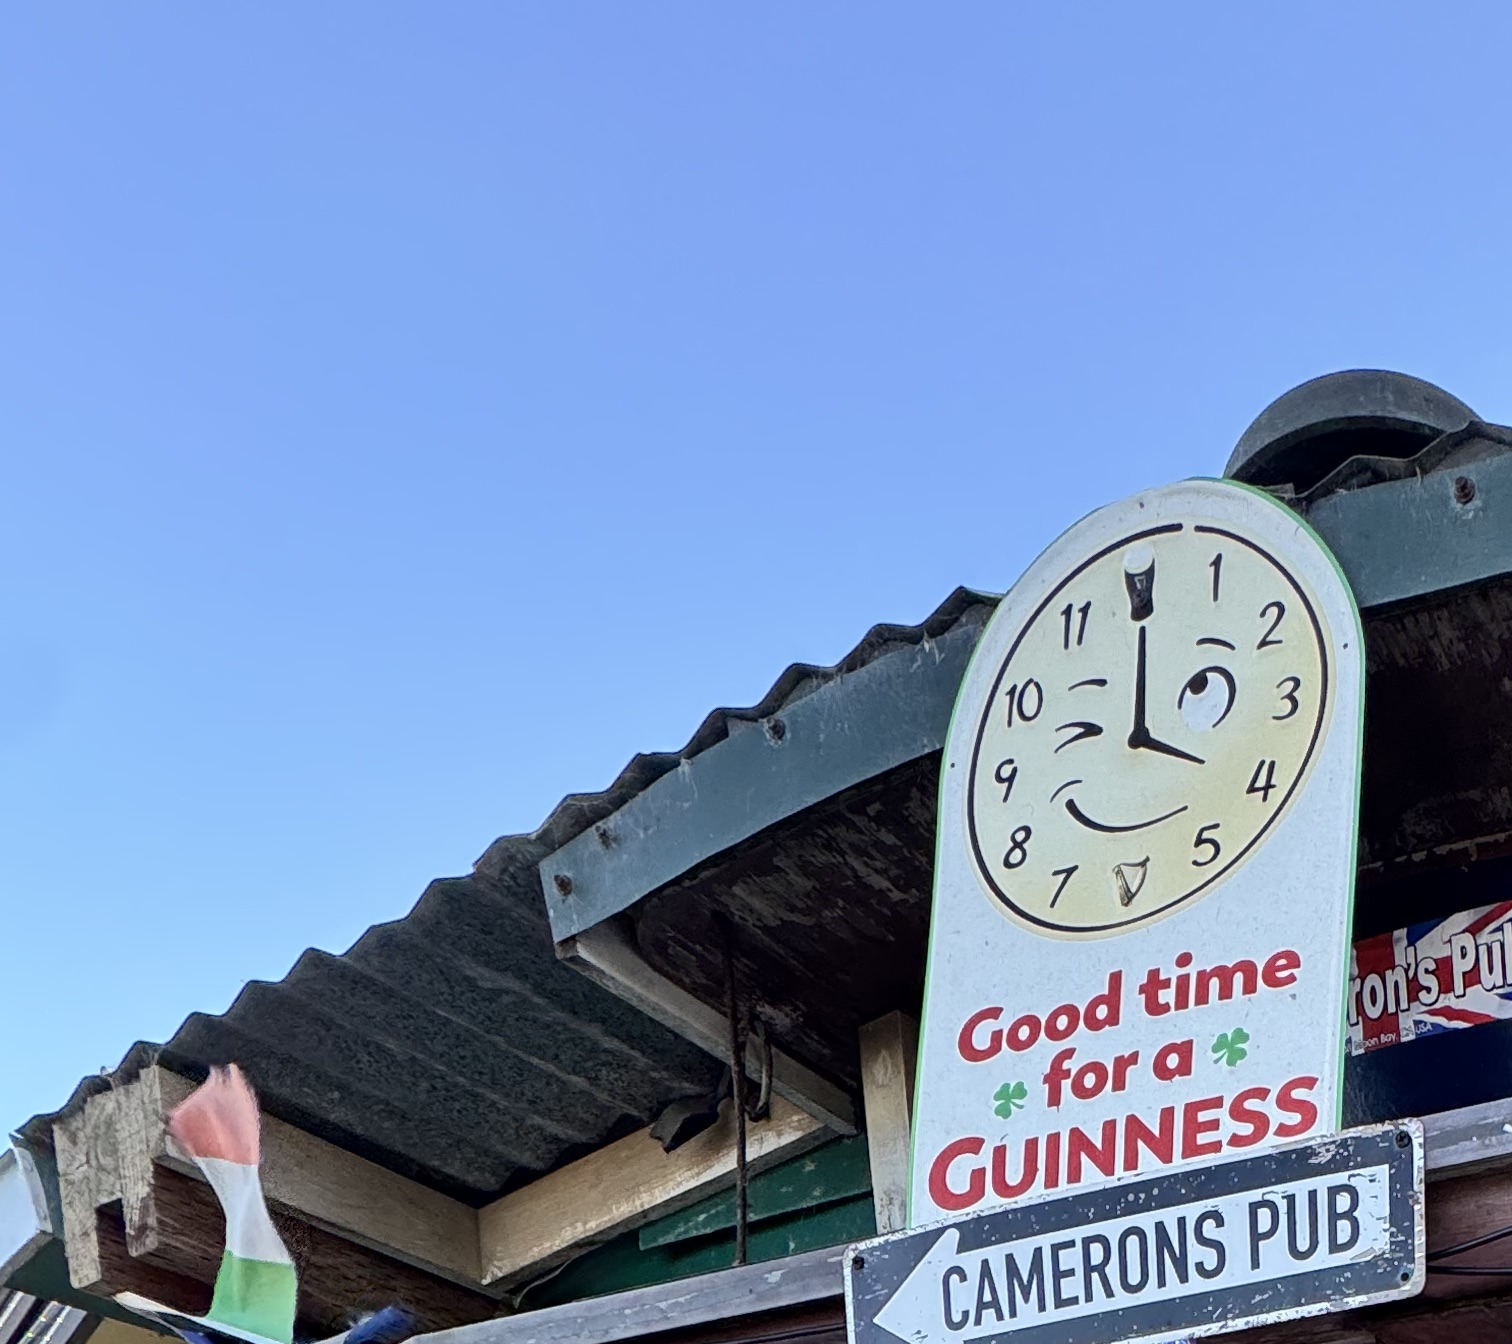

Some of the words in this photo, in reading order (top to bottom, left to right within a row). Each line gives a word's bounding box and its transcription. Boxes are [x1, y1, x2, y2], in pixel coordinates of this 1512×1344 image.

[1208, 554, 1223, 601] 1
[1061, 602, 1091, 650] 11
[1257, 602, 1285, 649] 2
[1006, 679, 1043, 728] 10
[1271, 677, 1300, 720] 3
[994, 758, 1019, 802] 9
[1246, 760, 1276, 802] 4
[1002, 826, 1031, 869] 8
[1191, 822, 1221, 869] 5
[1051, 865, 1078, 908] 7
[957, 971, 1122, 1062] Good
[1139, 949, 1301, 1018] time
[1043, 1051, 1140, 1108] for
[1152, 1038, 1194, 1082] a
[928, 1076, 1320, 1211] GUINNESS
[941, 1211, 1226, 1332] CAMERONS
[1249, 1182, 1361, 1271] PUB
